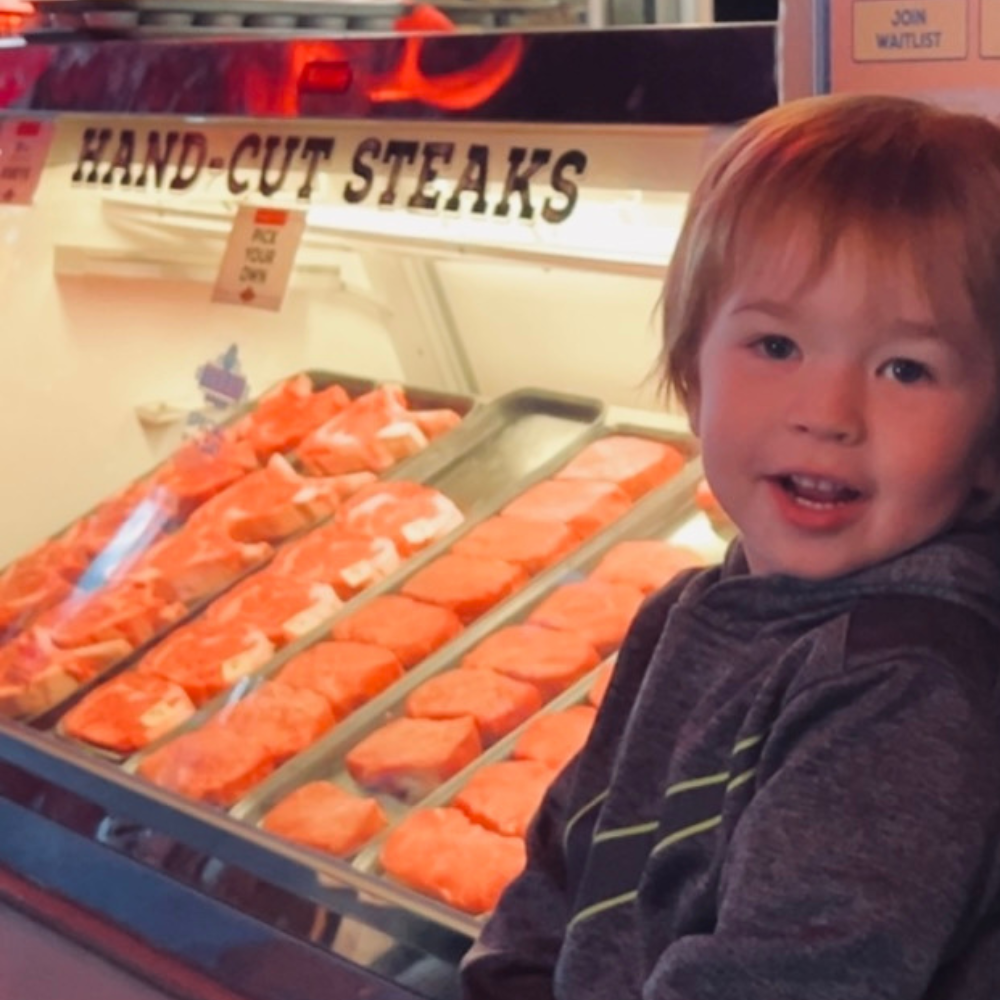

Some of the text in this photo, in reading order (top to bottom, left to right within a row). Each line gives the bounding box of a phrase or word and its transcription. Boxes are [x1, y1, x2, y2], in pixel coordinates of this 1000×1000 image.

[891, 9, 927, 26] JOIN
[876, 32, 942, 49] WAITLIST
[71, 127, 588, 225] HAND-CUT STEAKS
